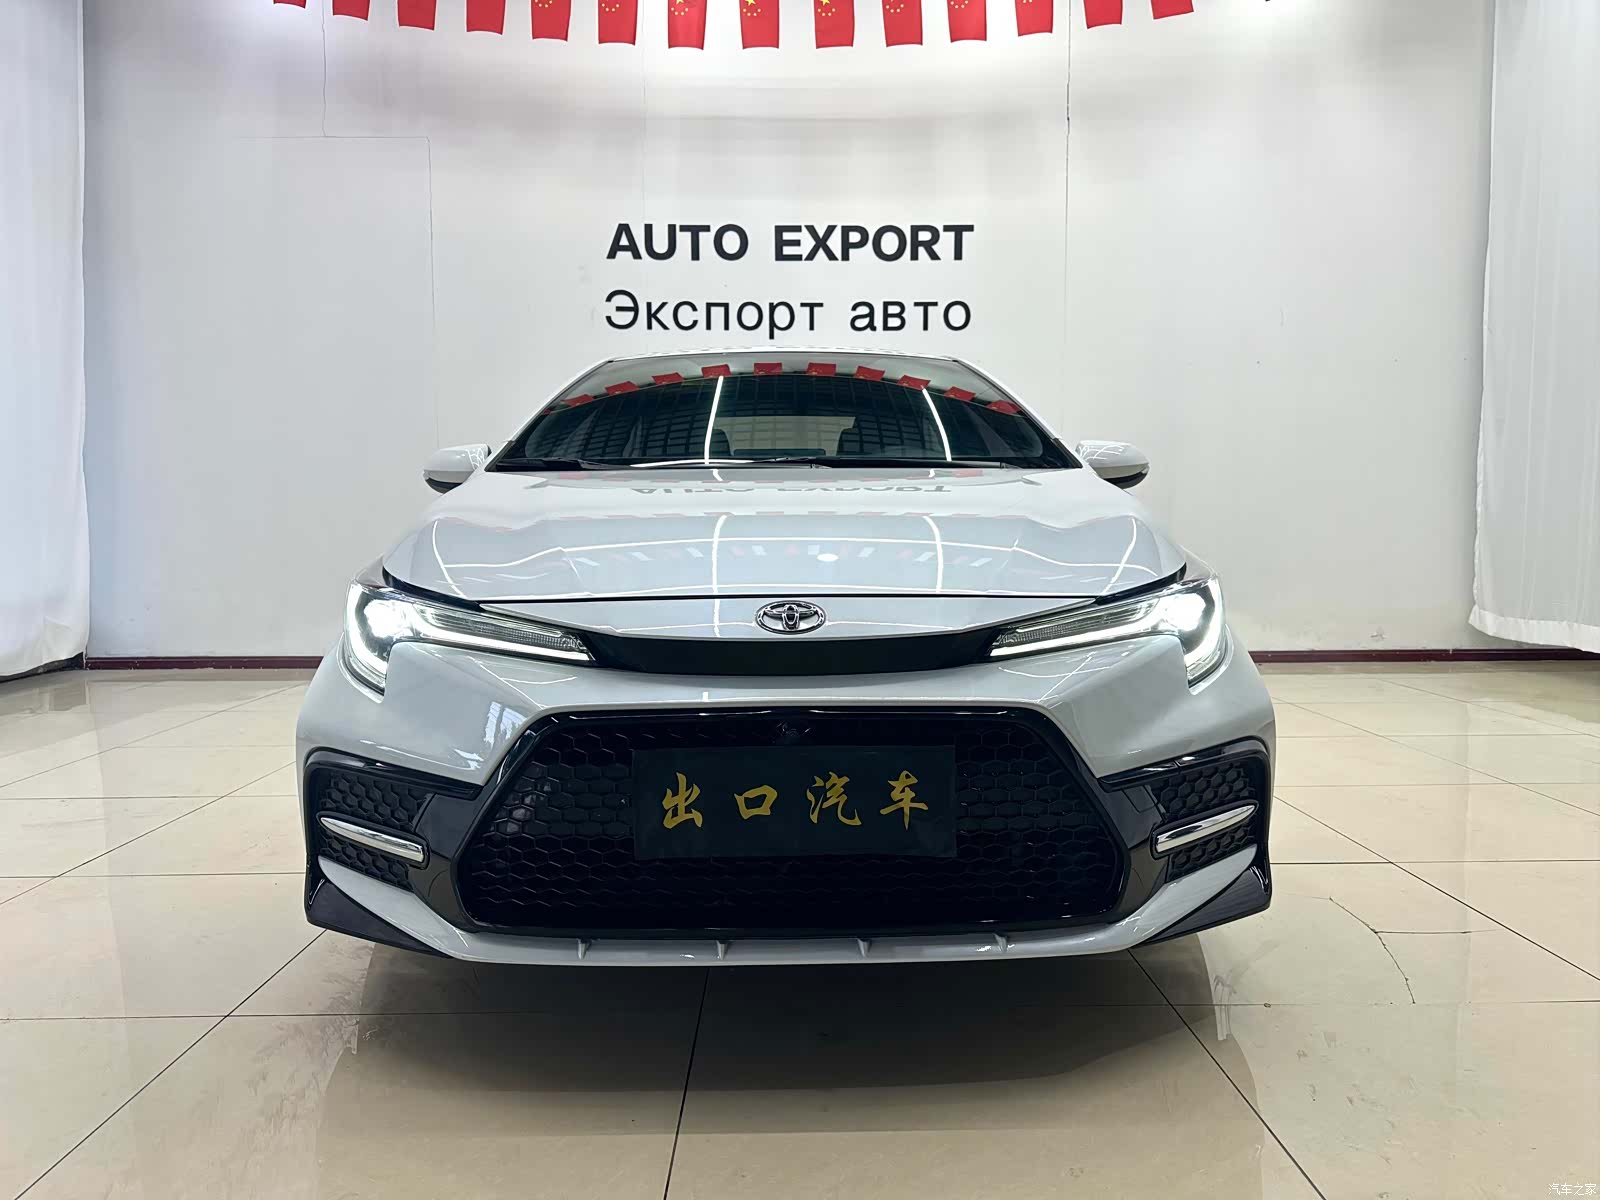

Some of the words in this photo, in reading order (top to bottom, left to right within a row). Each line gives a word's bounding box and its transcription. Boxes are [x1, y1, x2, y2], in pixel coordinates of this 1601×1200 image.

[606, 223, 749, 261] AUTO
[774, 224, 974, 262] EXPORT
[605, 289, 824, 339] Экспорт
[850, 300, 971, 331] авто
[661, 770, 929, 830] 出口汽车
